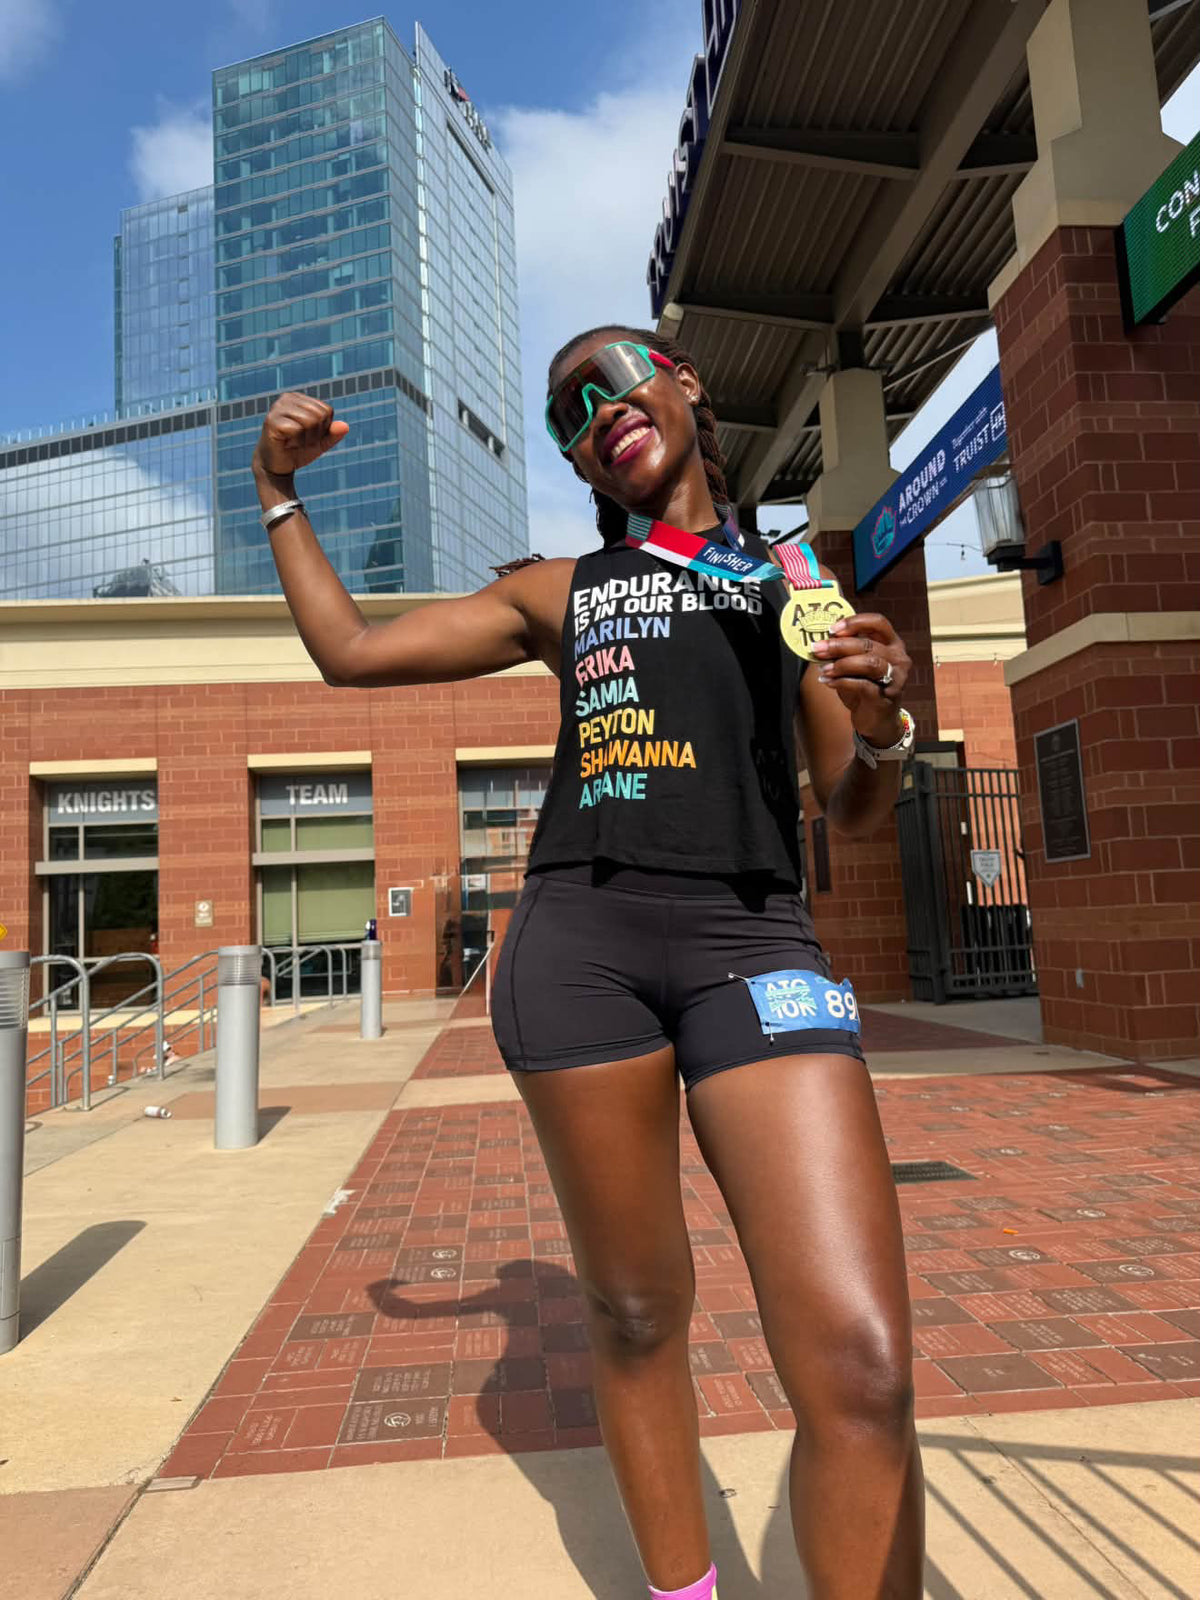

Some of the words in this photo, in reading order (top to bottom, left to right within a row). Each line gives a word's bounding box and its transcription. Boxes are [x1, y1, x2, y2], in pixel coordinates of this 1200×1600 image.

[953, 423, 989, 473] TRUIST
[899, 449, 946, 514] AROUND
[907, 481, 940, 524] CROWN
[703, 546, 753, 572] FINISHER
[573, 570, 762, 616] ENDURANCE
[575, 611, 590, 637] IS
[594, 600, 616, 621] IN
[623, 595, 673, 613] OUR
[682, 592, 763, 616] BLOOD
[574, 616, 671, 661] MARILYN
[575, 645, 636, 688] ERIKA
[575, 676, 640, 717] SAMIA
[578, 707, 655, 748] PEYTON
[57, 789, 156, 814] KNIGHTS
[285, 783, 348, 805] TEAM
